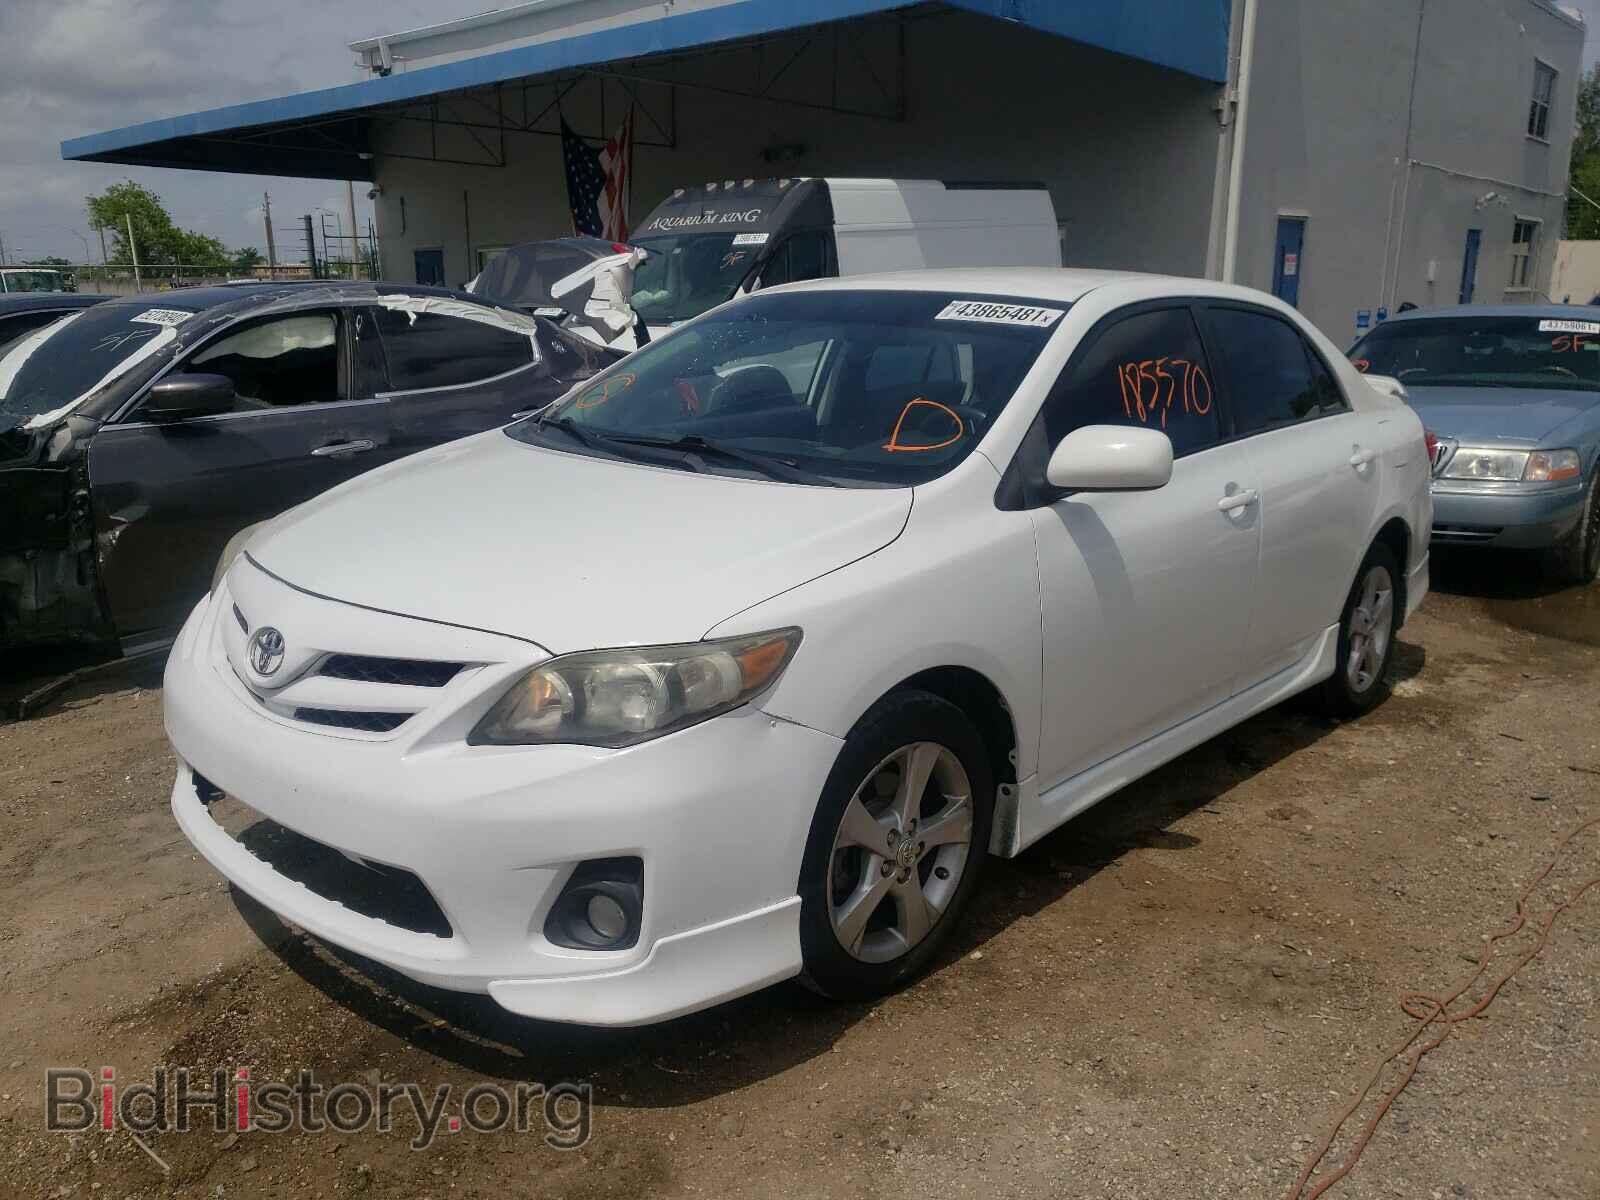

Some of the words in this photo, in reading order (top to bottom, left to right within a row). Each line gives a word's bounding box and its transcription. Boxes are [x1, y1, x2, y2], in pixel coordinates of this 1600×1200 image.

[648, 213, 719, 231] AQUARIUM
[720, 209, 761, 223] KING
[956, 303, 1048, 322] 43865481
